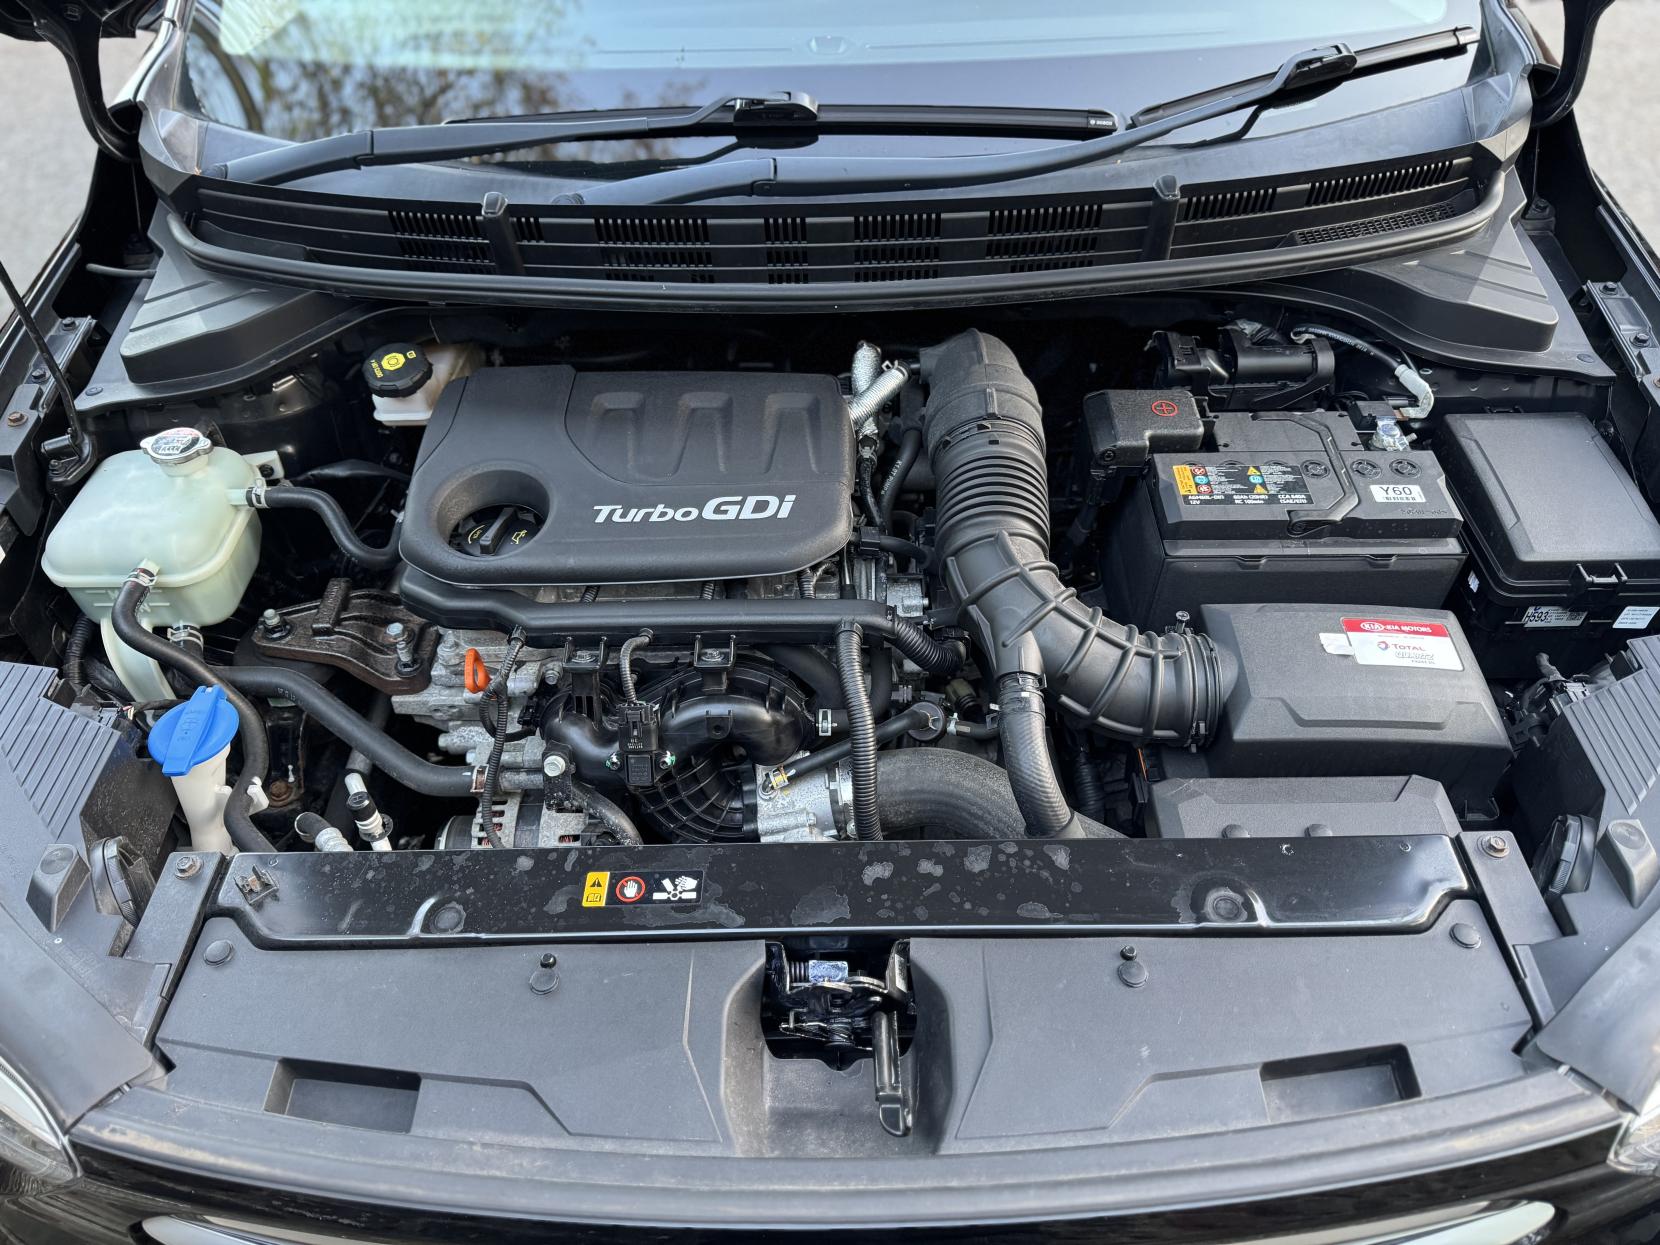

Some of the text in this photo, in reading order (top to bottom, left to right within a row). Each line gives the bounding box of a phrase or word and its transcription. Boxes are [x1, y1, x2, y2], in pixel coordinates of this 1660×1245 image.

[1379, 486, 1413, 496] Y60
[593, 494, 797, 523] Turbo GDi
[1361, 622, 1383, 631] KIA
[1401, 625, 1432, 633] MOTORS
[1391, 643, 1426, 651] TOTAL
